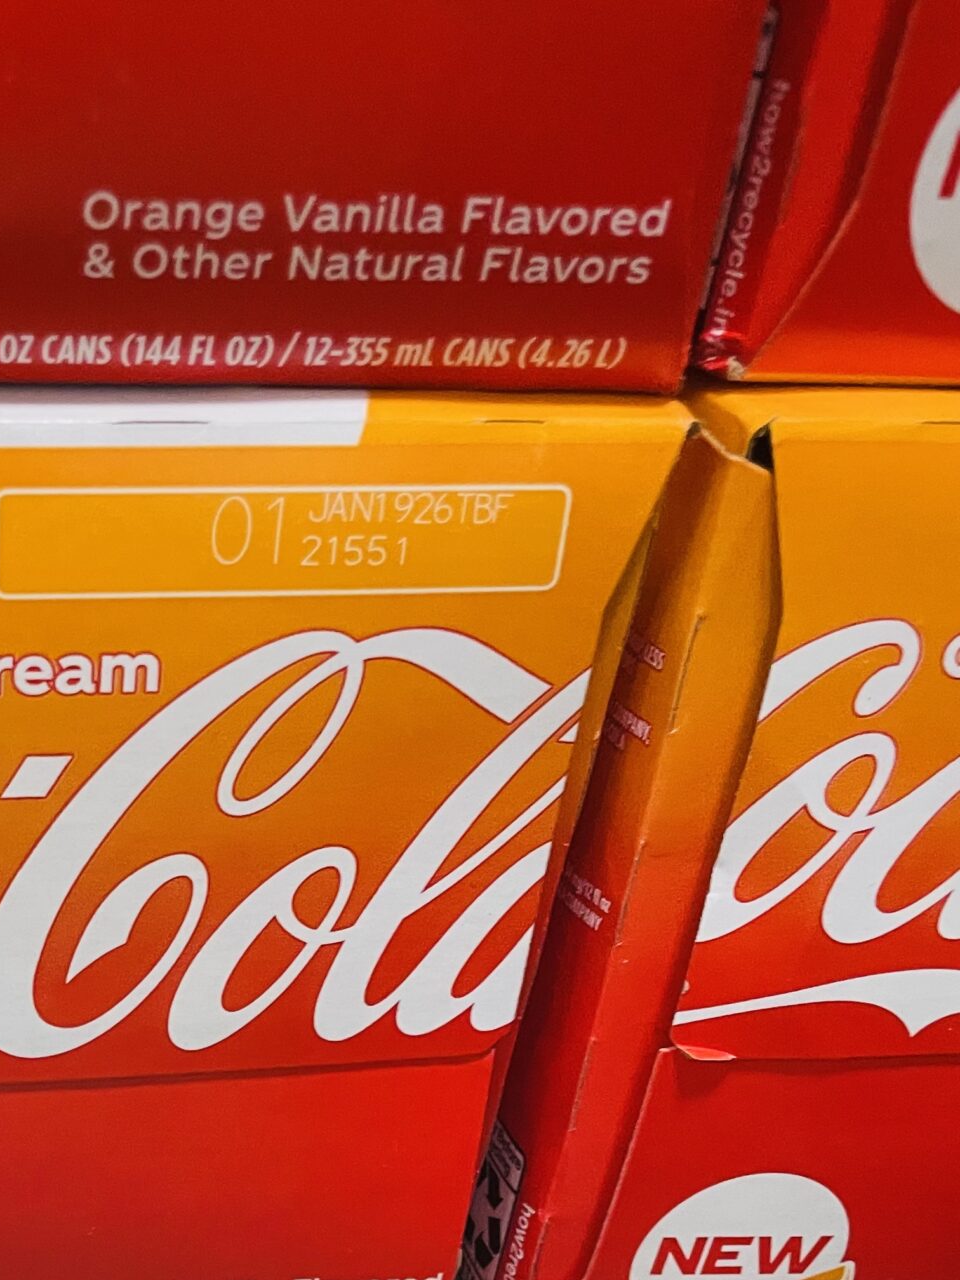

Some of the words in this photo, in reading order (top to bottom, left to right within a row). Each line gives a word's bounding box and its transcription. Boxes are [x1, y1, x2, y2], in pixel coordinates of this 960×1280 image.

[82, 191, 263, 239] Orange
[282, 194, 443, 234] Vanilla
[460, 196, 670, 237] Flavored
[83, 243, 115, 279] &
[132, 243, 272, 281] Other
[288, 244, 463, 283] Natural
[480, 246, 652, 285] Flavors
[41, 335, 112, 365] CANS
[120, 333, 180, 366] (144
[188, 336, 216, 366] FL
[225, 334, 275, 367] OZ)
[304, 336, 389, 367] 12-355
[393, 338, 435, 367] mL
[444, 338, 511, 367] CANS
[518, 336, 591, 369] (4.26
[595, 338, 628, 370] L)
[211, 495, 284, 566] 01
[650, 1236, 834, 1276] NEW
